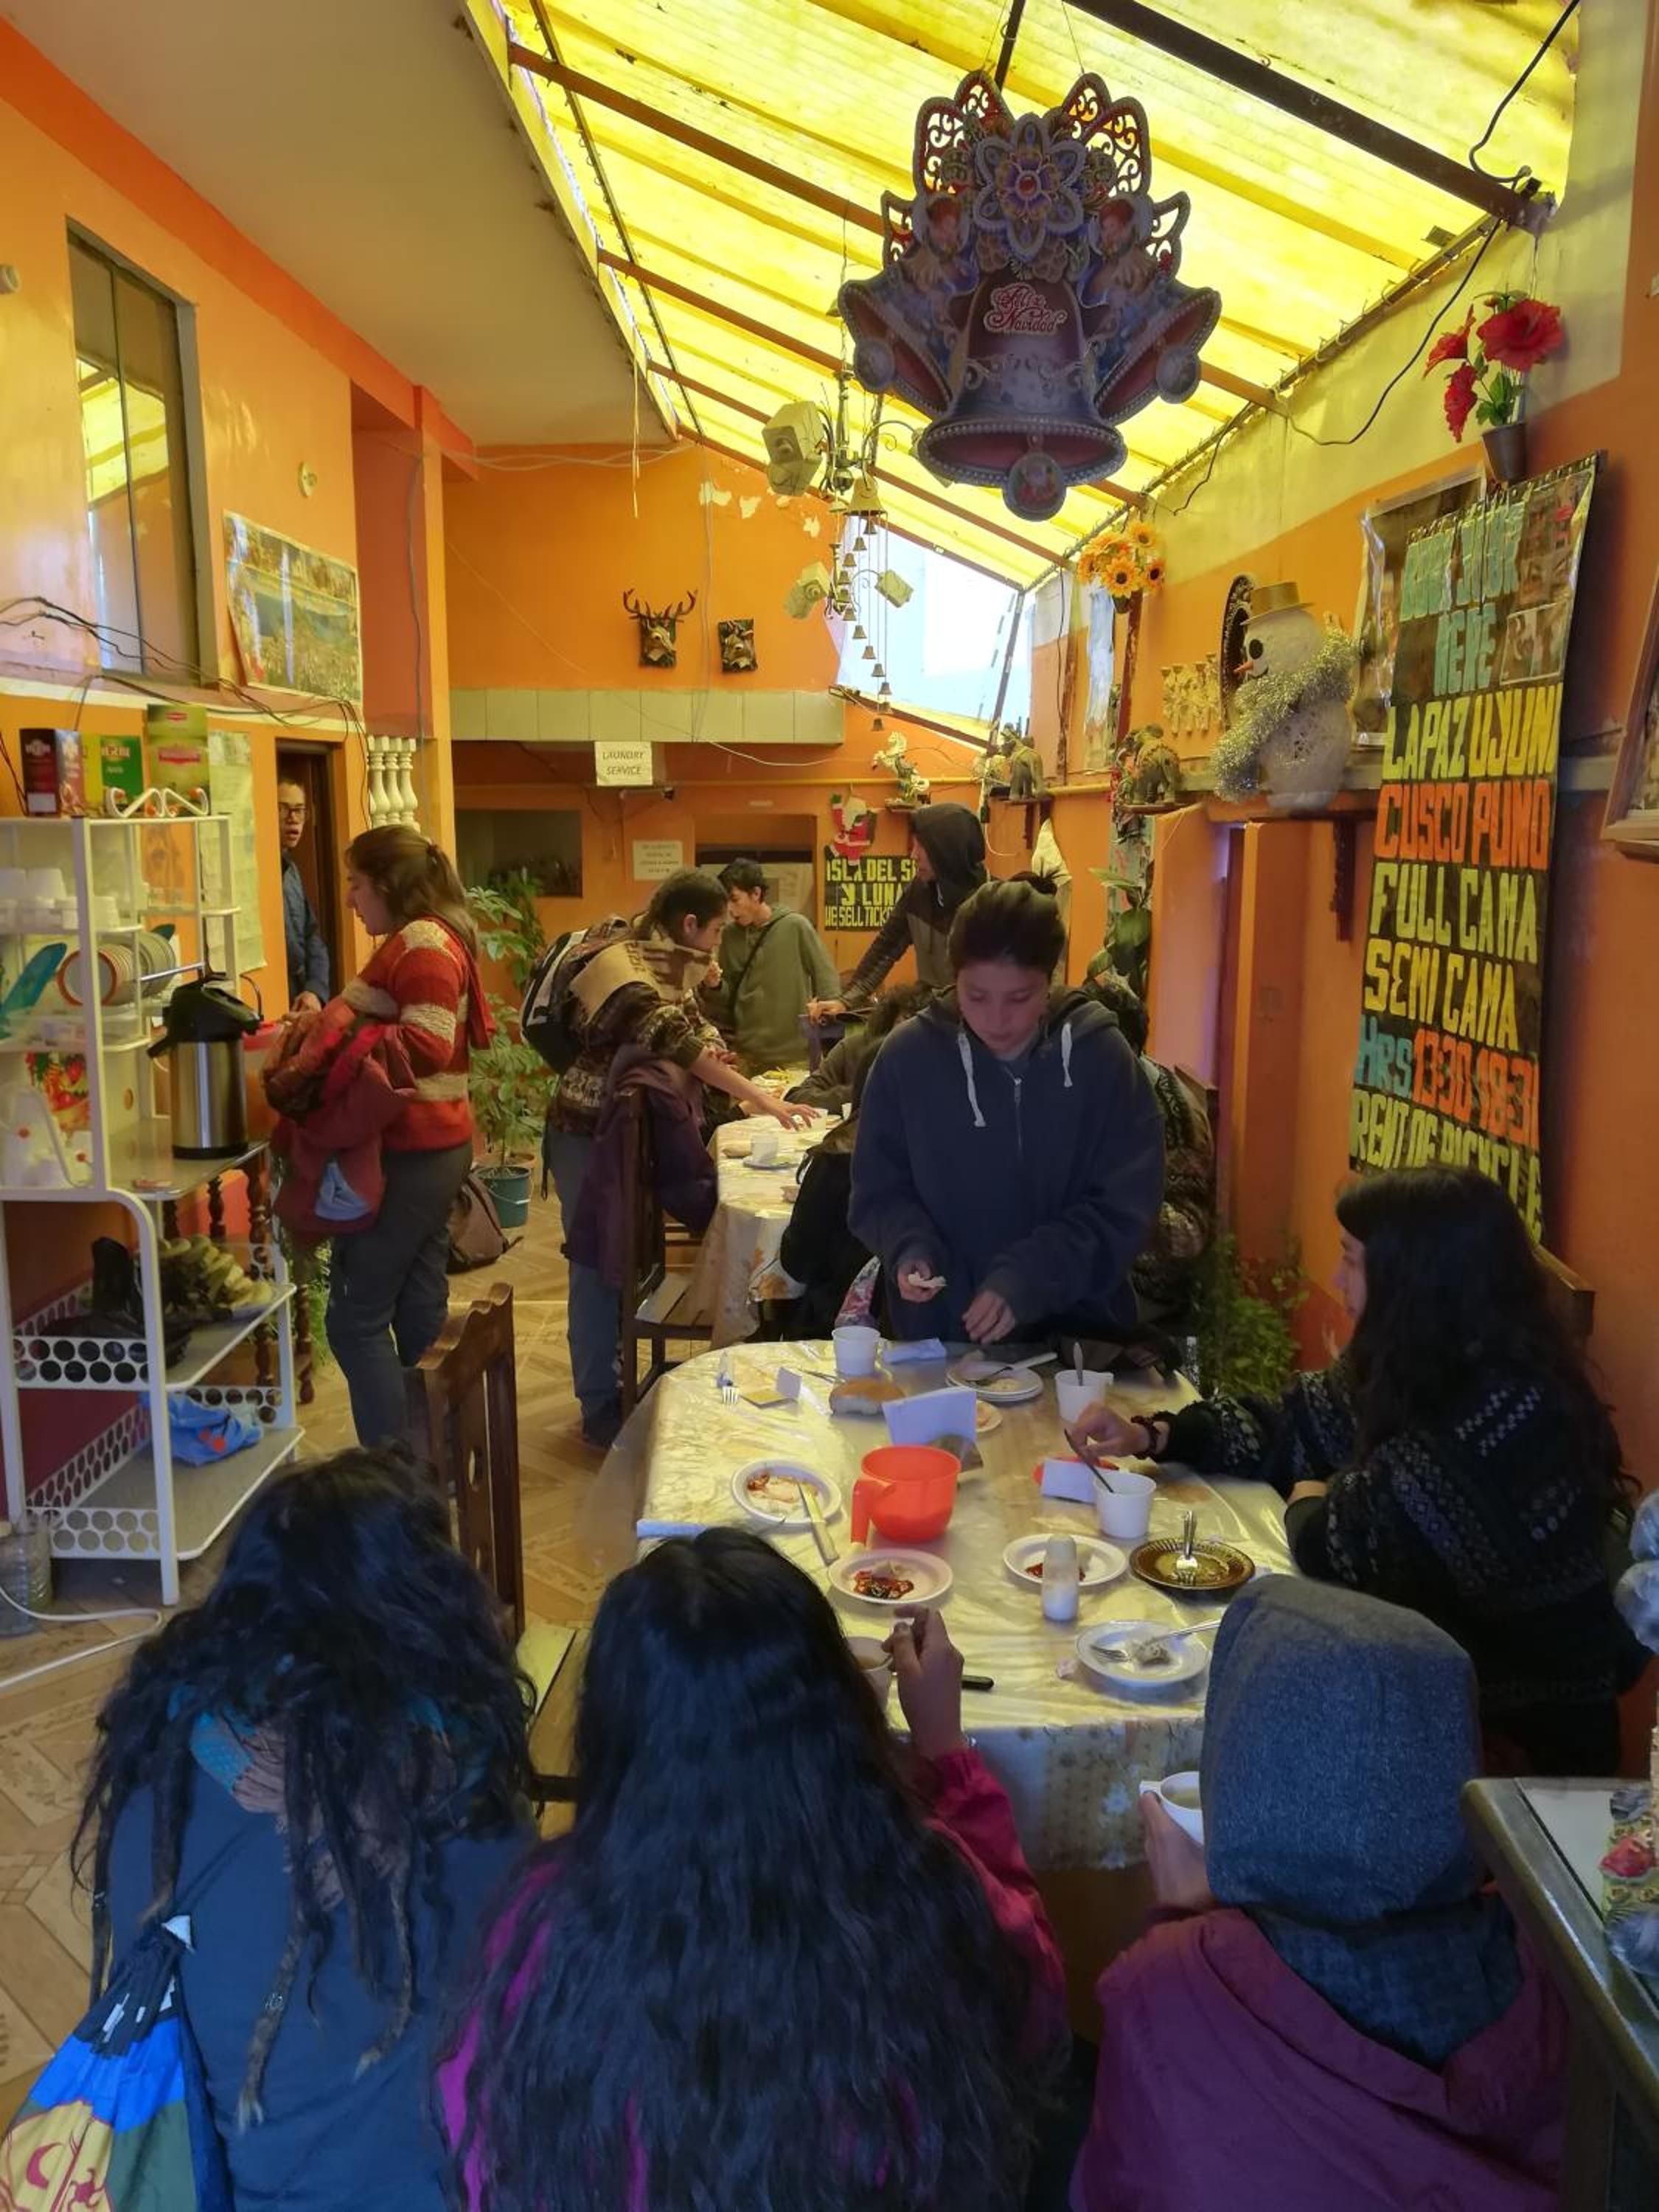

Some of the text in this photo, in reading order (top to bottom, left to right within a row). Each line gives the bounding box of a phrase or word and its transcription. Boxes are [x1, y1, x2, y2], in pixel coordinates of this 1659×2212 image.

[989, 305, 1066, 331] Navidad
[602, 751, 644, 760] LAUNDRY
[1469, 682, 1562, 778] UYUNI
[606, 765, 641, 775] SERVICE
[1374, 779, 1549, 871] CUSCO PUNO
[827, 858, 863, 882] ISLA
[866, 858, 897, 882] DEL
[825, 905, 838, 926] WE
[839, 905, 863, 926] SELL
[1369, 861, 1538, 964] FULL CAMA
[1364, 939, 1518, 1051] SEMI CAMA
[1349, 1089, 1410, 1169] RENT
